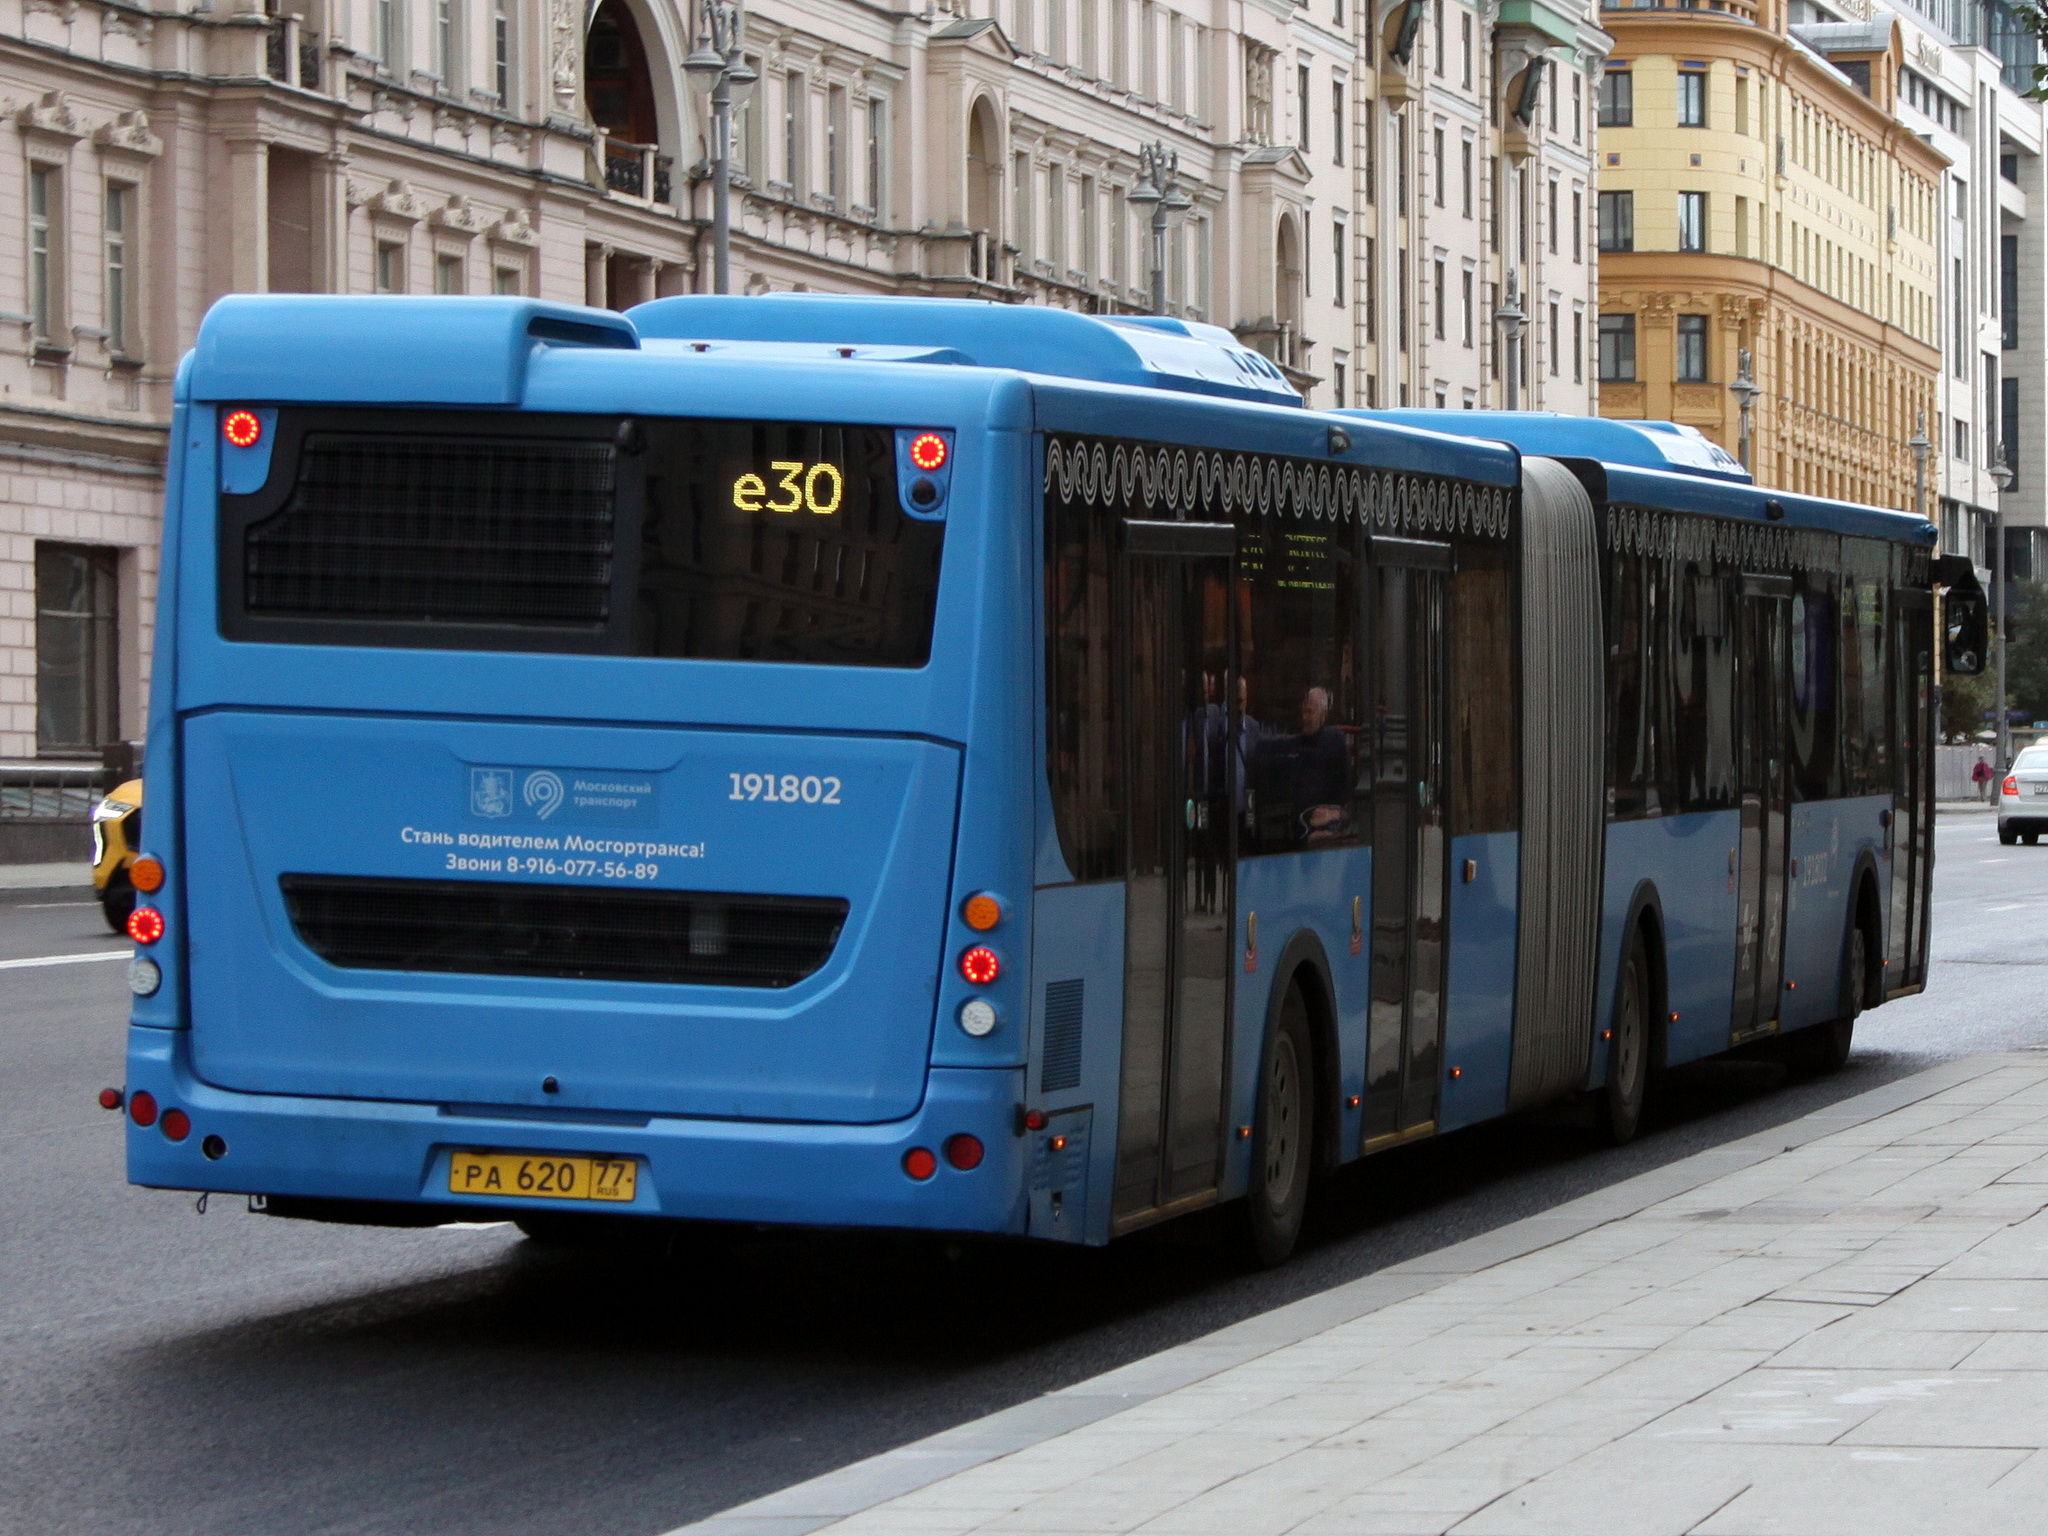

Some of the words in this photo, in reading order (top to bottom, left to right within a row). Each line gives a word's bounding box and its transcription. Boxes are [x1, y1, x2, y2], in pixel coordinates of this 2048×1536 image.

[573, 779, 652, 795] Московский
[729, 773, 842, 805] 191802
[573, 796, 638, 809] транспорт
[401, 827, 454, 846] Стань
[458, 833, 560, 852] водителем
[564, 835, 706, 858] Мосгортранса!
[445, 854, 502, 873] Звони
[506, 858, 659, 880] 8-916-077-56-89
[517, 1161, 576, 1192] 620
[595, 1163, 626, 1187] 77
[597, 1187, 619, 1196] RUS
